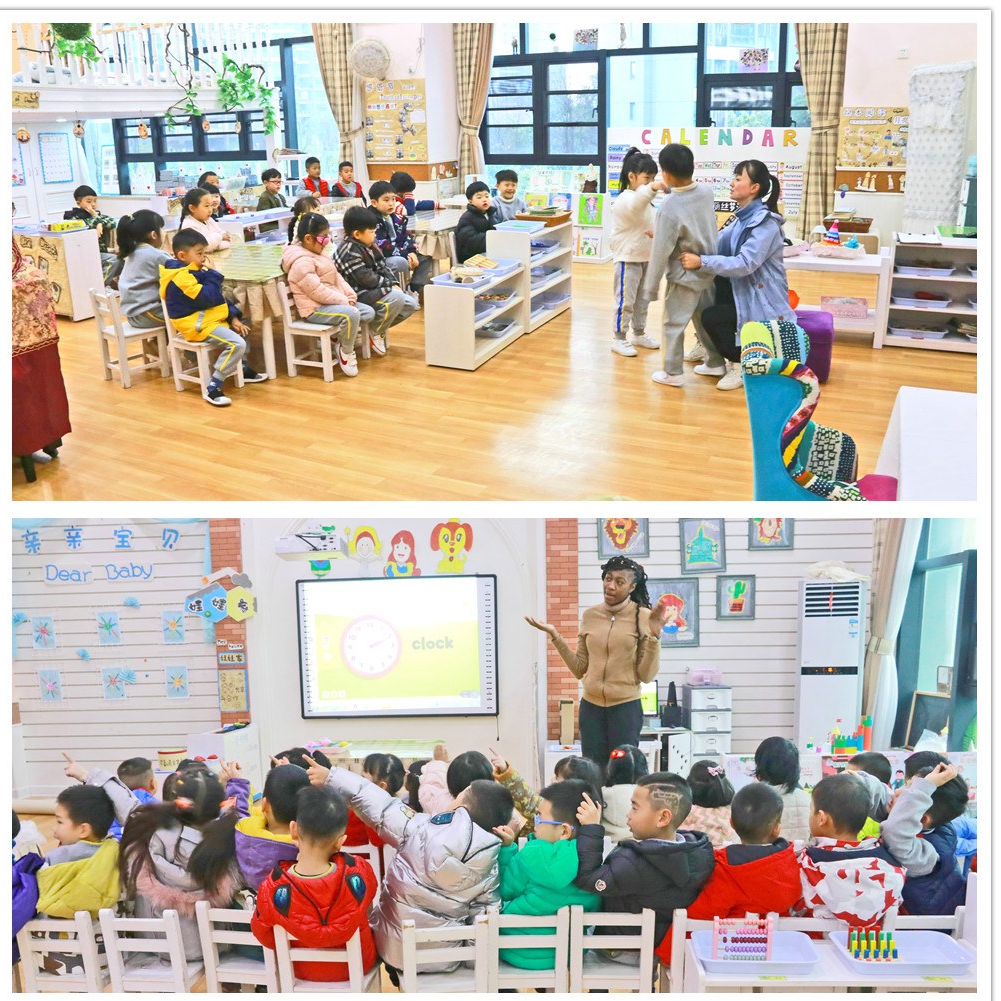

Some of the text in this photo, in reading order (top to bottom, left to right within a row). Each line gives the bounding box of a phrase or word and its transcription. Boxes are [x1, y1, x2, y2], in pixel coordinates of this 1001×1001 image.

[641, 128, 798, 147] CALENDAR
[21, 525, 179, 554] 亲亲宝贝
[45, 561, 153, 582] Dear Baby
[412, 636, 454, 650] clock
